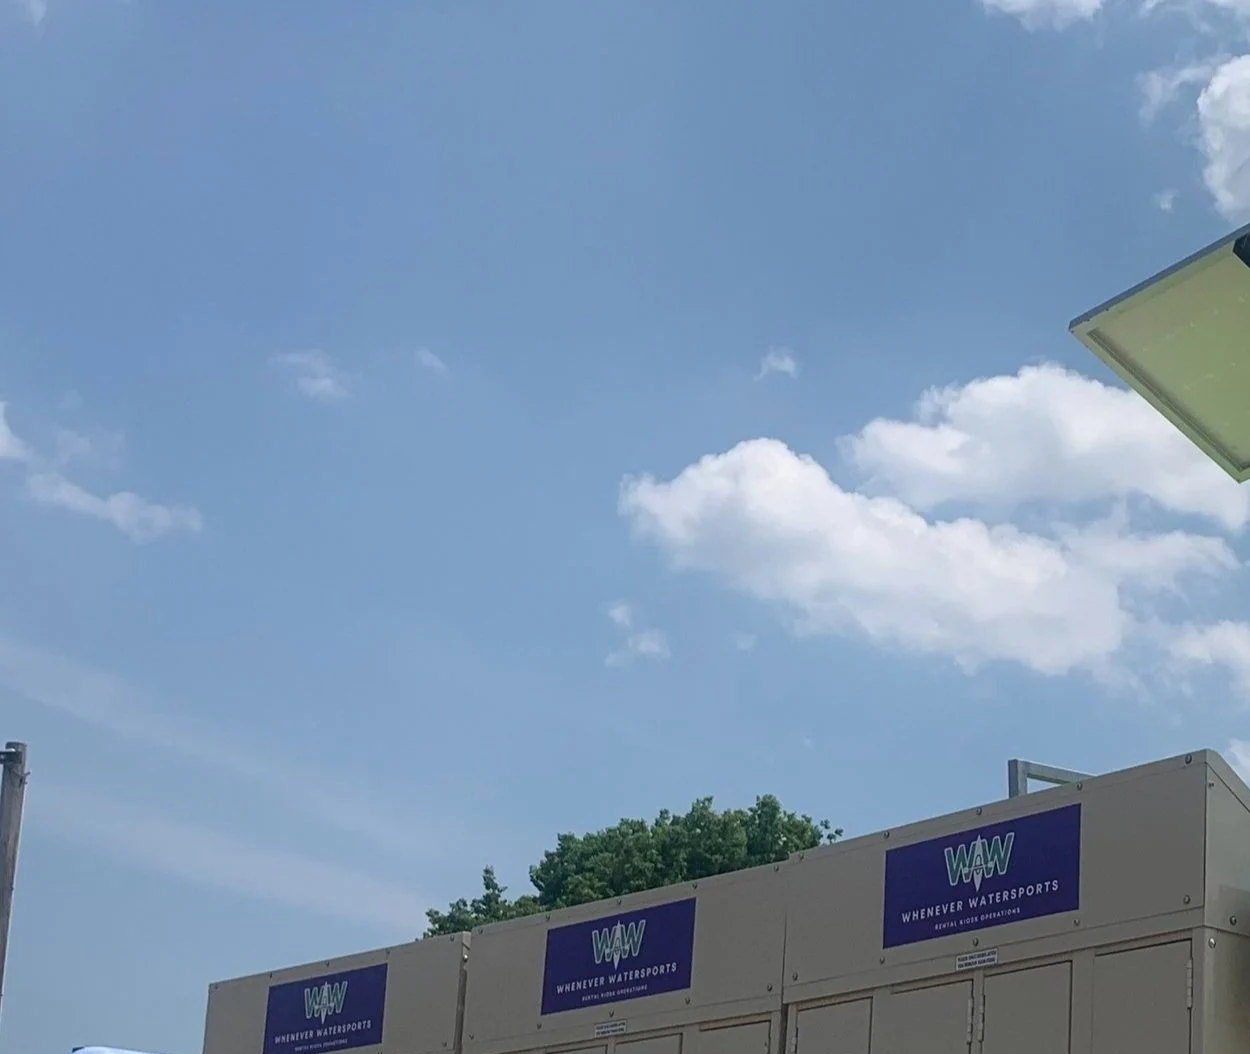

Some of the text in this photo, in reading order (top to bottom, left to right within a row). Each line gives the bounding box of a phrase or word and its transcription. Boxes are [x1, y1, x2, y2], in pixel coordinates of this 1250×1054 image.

[901, 879, 1059, 923] WHENEVER WATERSPORTS
[934, 907, 1021, 930] RENTAL KIOSK OPERATIONS
[556, 962, 677, 995] WHENEVER WATERSPORTS
[274, 1020, 371, 1044] WHENEVER WATERSPORTS
